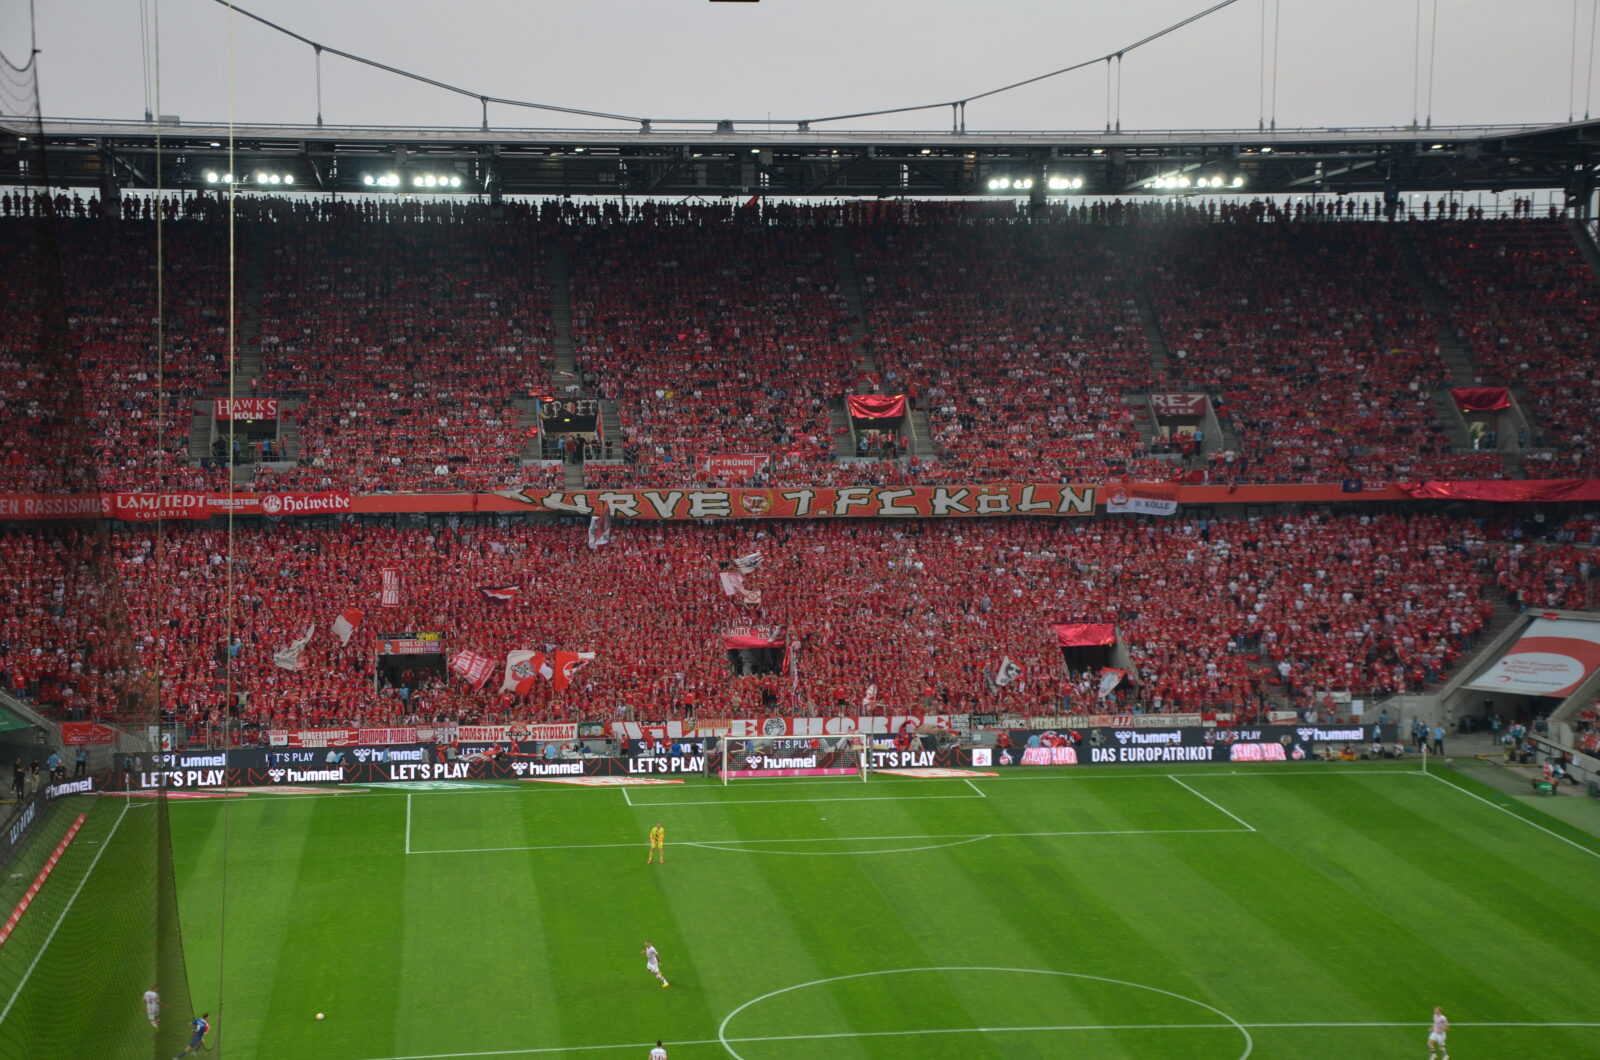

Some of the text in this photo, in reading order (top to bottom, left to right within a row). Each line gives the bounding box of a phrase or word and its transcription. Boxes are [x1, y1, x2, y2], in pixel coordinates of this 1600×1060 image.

[217, 399, 277, 416] HAWKS
[234, 410, 264, 420] KÖLN
[723, 457, 755, 466] FRÜNDE
[25, 498, 110, 515] RASSISMUS
[117, 494, 207, 509] LAMSTEDT
[283, 494, 350, 512] Holweide
[500, 489, 731, 519] URVE
[931, 485, 1094, 514] KÖLN
[135, 509, 188, 518] COLONIA
[360, 729, 388, 744] SEMPER
[390, 727, 416, 743] FIDELIS
[458, 727, 505, 741] DOMSTADT
[531, 725, 575, 740] SYNDIKAT
[1132, 730, 1181, 743] hummel
[1216, 731, 1261, 741] LES PLAY
[1314, 727, 1364, 741] hummel
[302, 739, 328, 748] STADION
[793, 740, 811, 749] PLA
[265, 752, 314, 763] LT'S PLAY
[372, 747, 424, 762] hmmel
[764, 754, 816, 769] hummel
[860, 751, 936, 768] LET'S PLAY
[1091, 747, 1116, 762] DAS
[1119, 746, 1214, 761] EUROPATRIKOT
[390, 762, 470, 780] LET'S PLAY
[530, 760, 584, 775] hummel
[629, 756, 704, 774] LET'S PLAY
[141, 769, 225, 788] LET'S PLAY
[287, 767, 344, 783] hummel
[50, 777, 92, 799] hummel
